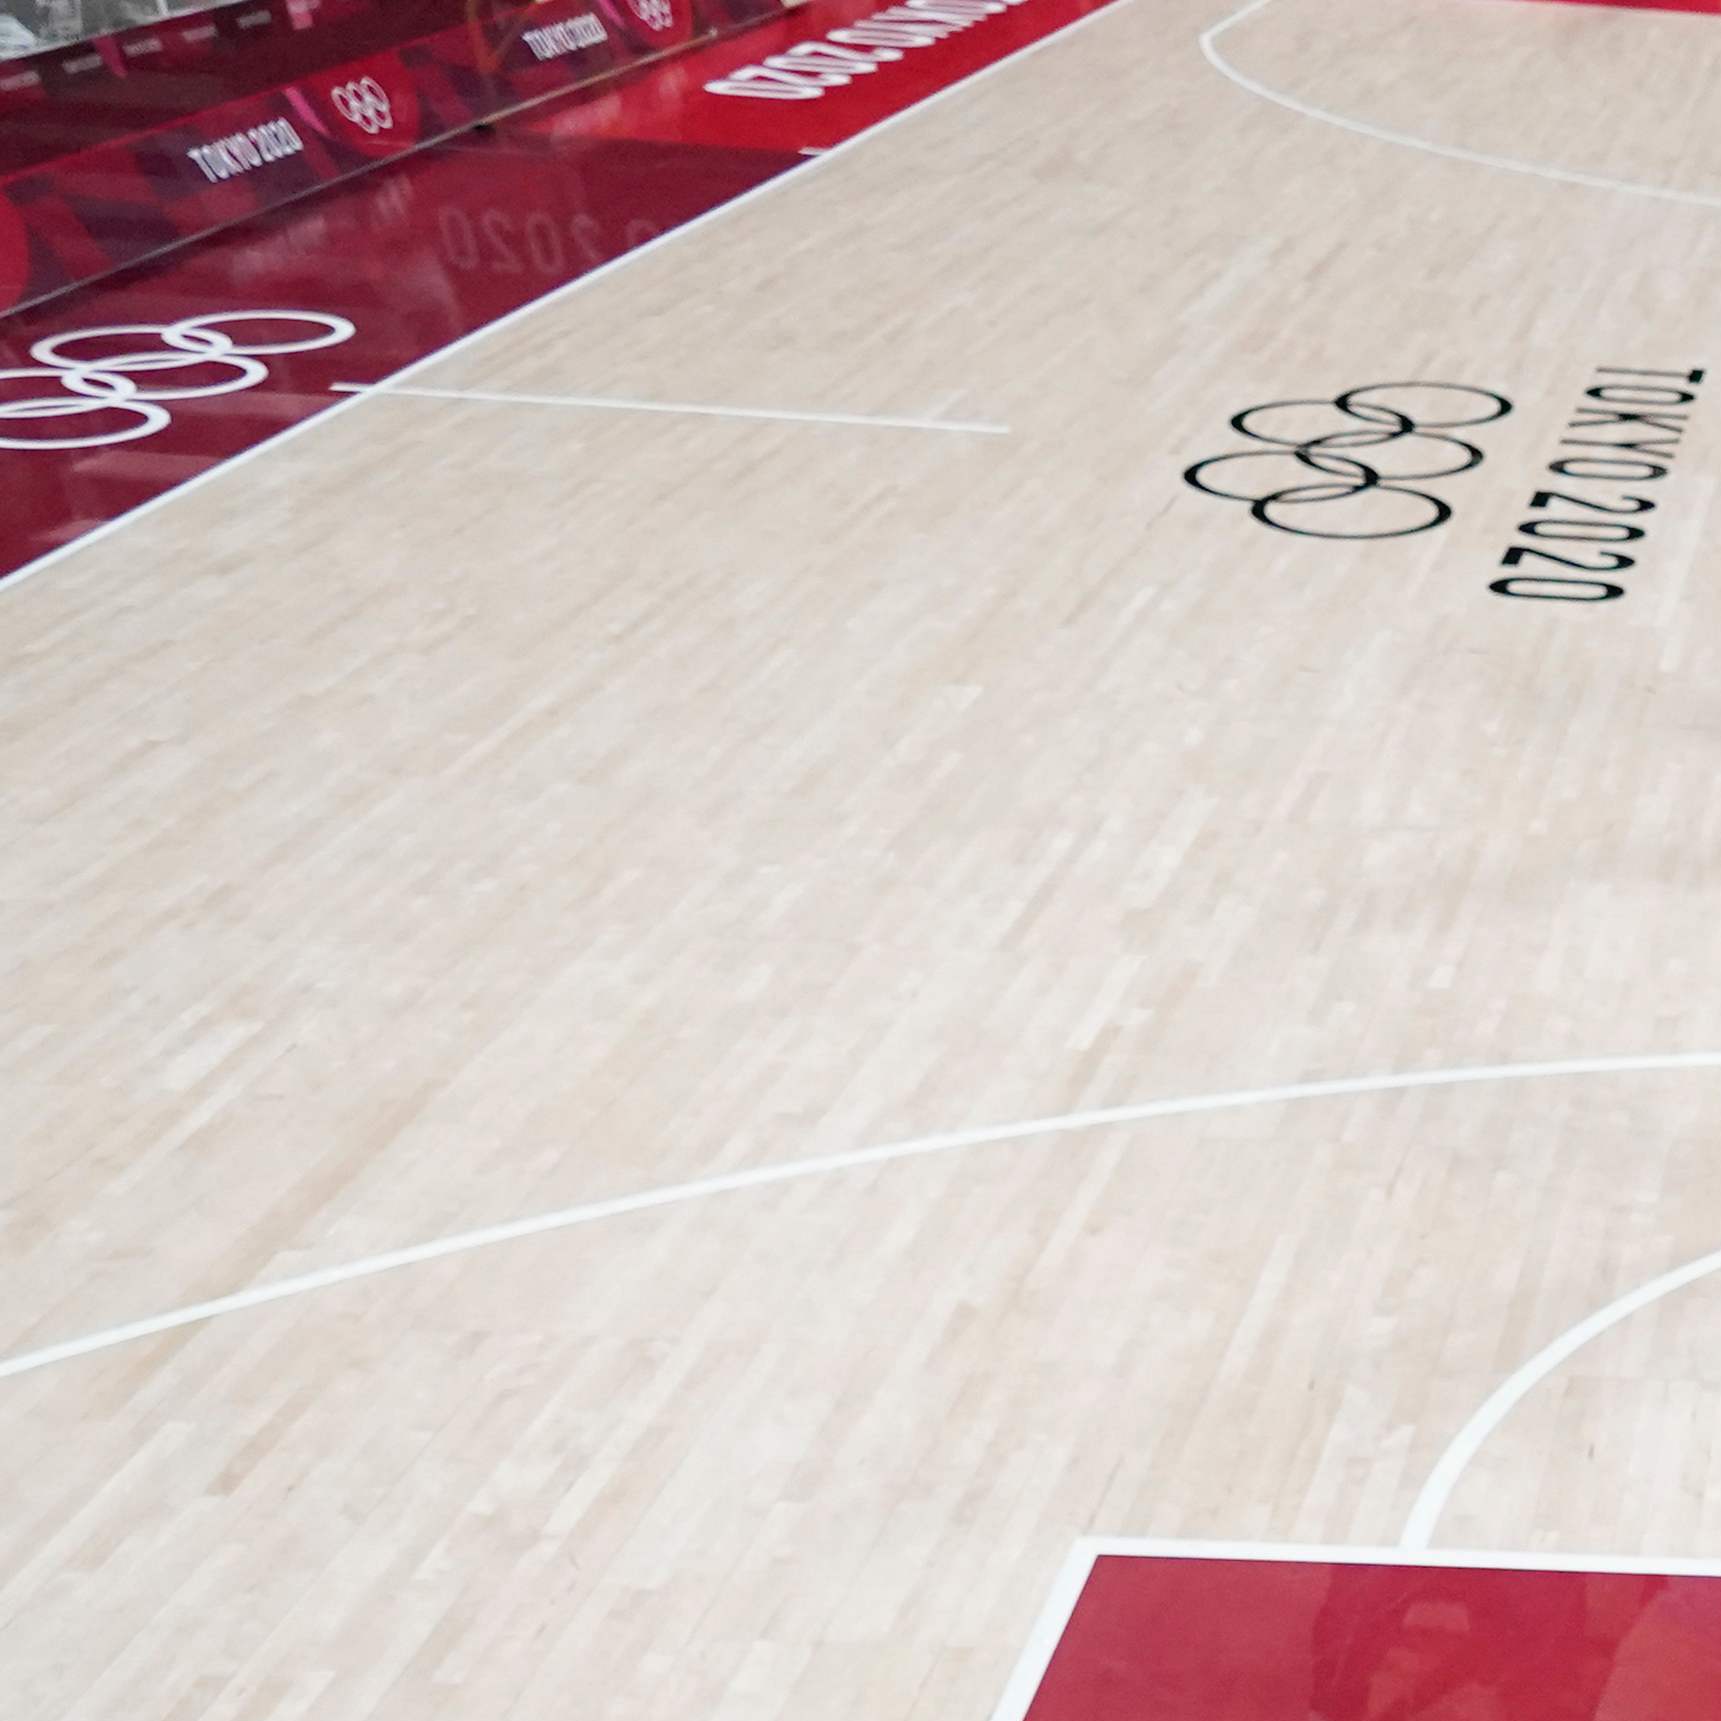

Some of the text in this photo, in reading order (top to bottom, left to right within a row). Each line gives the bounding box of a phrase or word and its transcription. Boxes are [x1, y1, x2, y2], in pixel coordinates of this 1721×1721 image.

[187, 116, 304, 184] TOKYO 2020
[1488, 368, 1706, 602] TOKYO 2020
